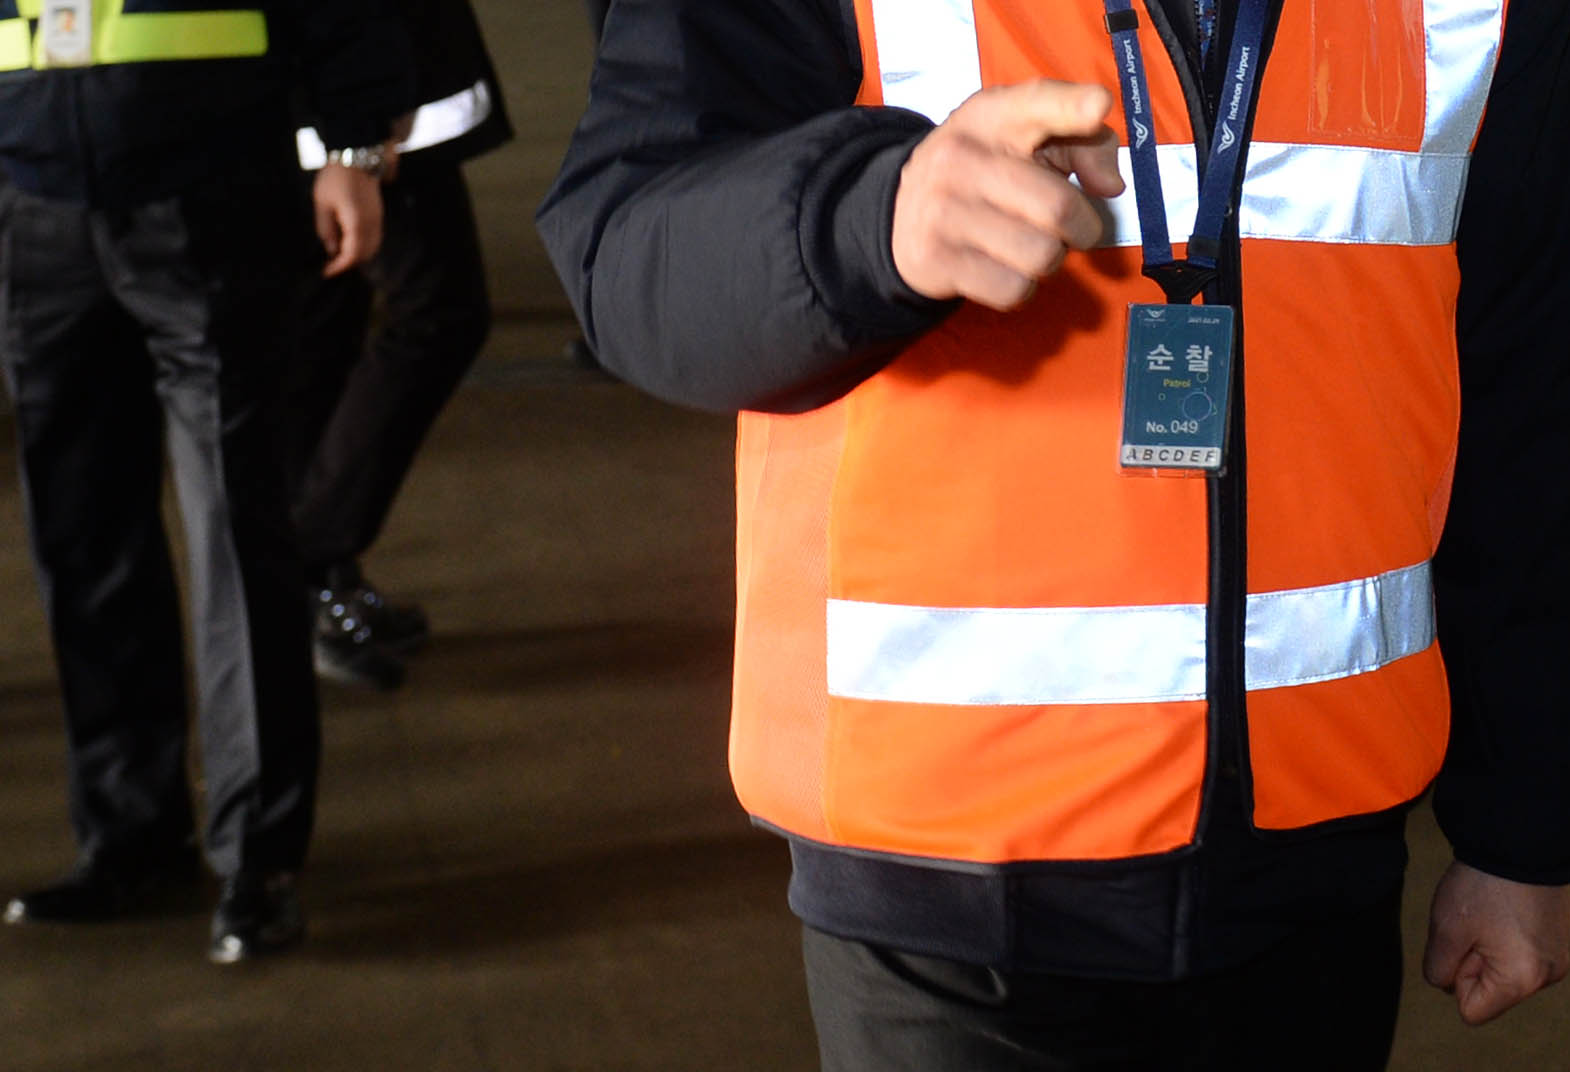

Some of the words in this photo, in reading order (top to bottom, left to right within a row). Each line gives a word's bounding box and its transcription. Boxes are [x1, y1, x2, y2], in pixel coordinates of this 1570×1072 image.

[1123, 39, 1136, 73] Airport
[1129, 76, 1142, 114] Incheon
[1227, 83, 1243, 120] Incheon
[1236, 46, 1250, 81] Airport
[1145, 421, 1168, 433] No.
[1170, 419, 1199, 434] 049
